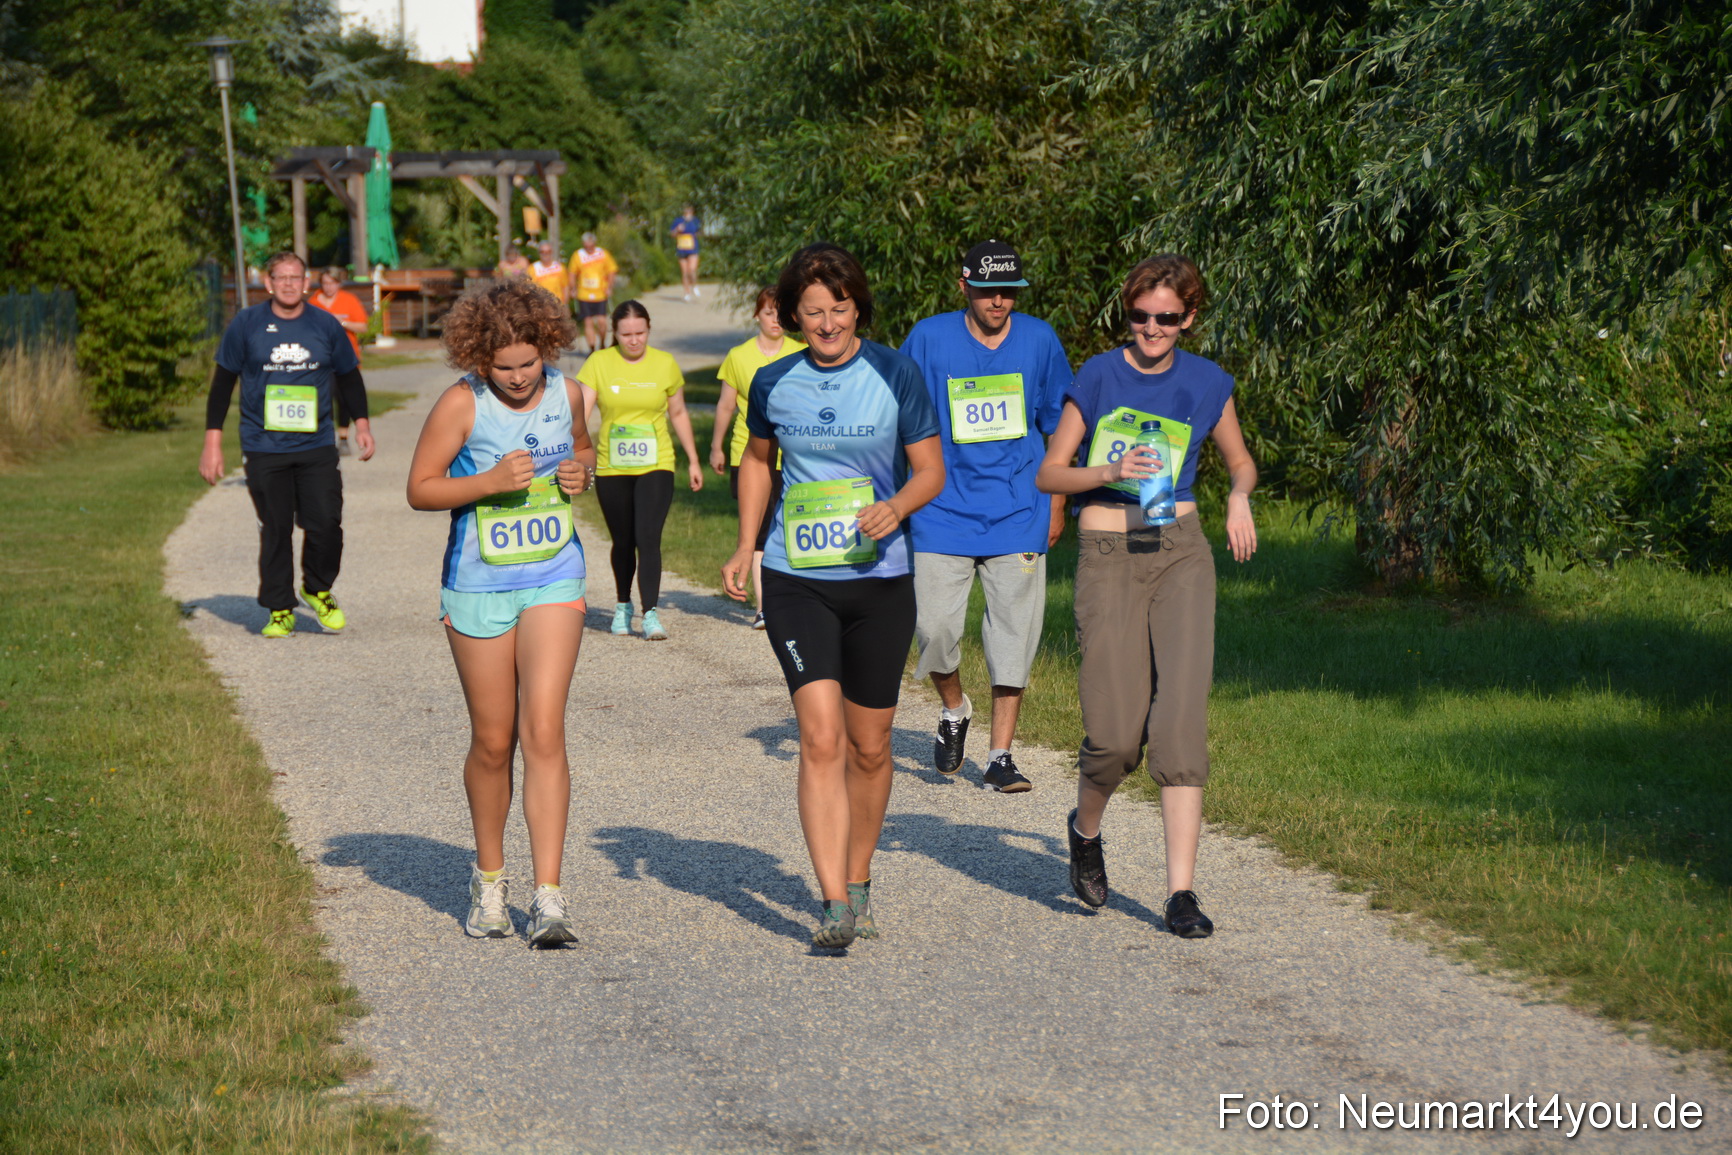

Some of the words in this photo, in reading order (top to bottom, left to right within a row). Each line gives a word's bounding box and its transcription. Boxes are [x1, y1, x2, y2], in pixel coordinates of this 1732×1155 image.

[978, 255, 1017, 280] Spurs
[276, 404, 306, 419] 166
[966, 400, 1008, 424] 801
[781, 424, 875, 437] SCHABMÜLLER
[617, 442, 648, 457] 649
[811, 443, 836, 451] TEAM
[490, 515, 562, 549] 6100
[796, 519, 862, 551] 6081
